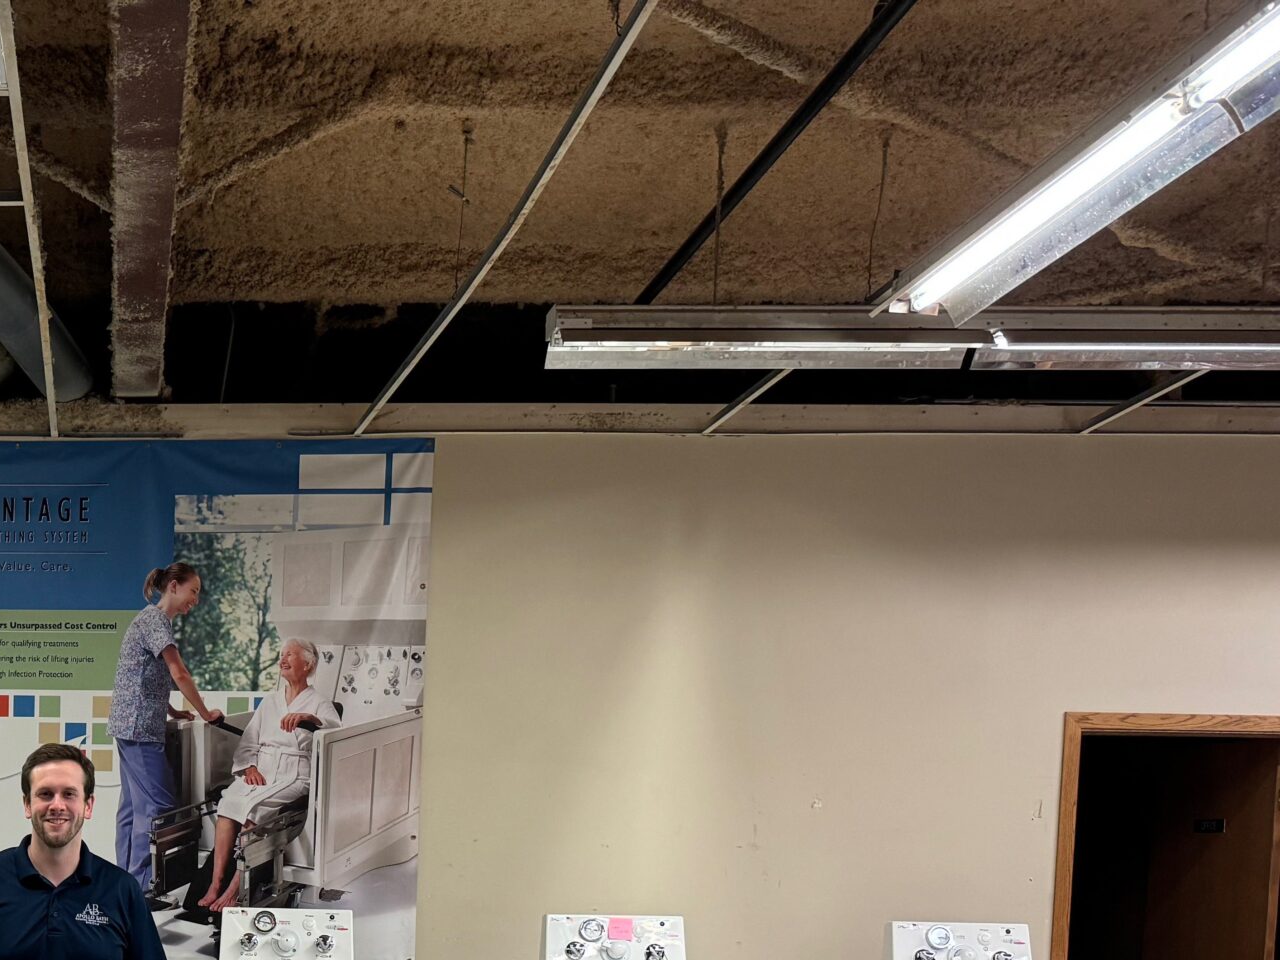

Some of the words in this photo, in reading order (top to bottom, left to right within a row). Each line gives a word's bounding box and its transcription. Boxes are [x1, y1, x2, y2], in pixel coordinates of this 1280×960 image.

[43, 530, 89, 543] SYSTEM
[0, 560, 36, 572] Value.
[40, 560, 74, 572] Care.
[10, 622, 62, 631] Unsurpassed
[64, 622, 84, 630] Cost
[85, 622, 117, 630] Control
[0, 639, 9, 647] for
[11, 640, 42, 649] qualifying
[43, 640, 79, 648] treatments
[42, 655, 50, 663] of
[51, 655, 69, 664] lifting
[70, 656, 95, 664] injuries
[8, 670, 37, 678] Infection
[38, 670, 73, 678] Protection
